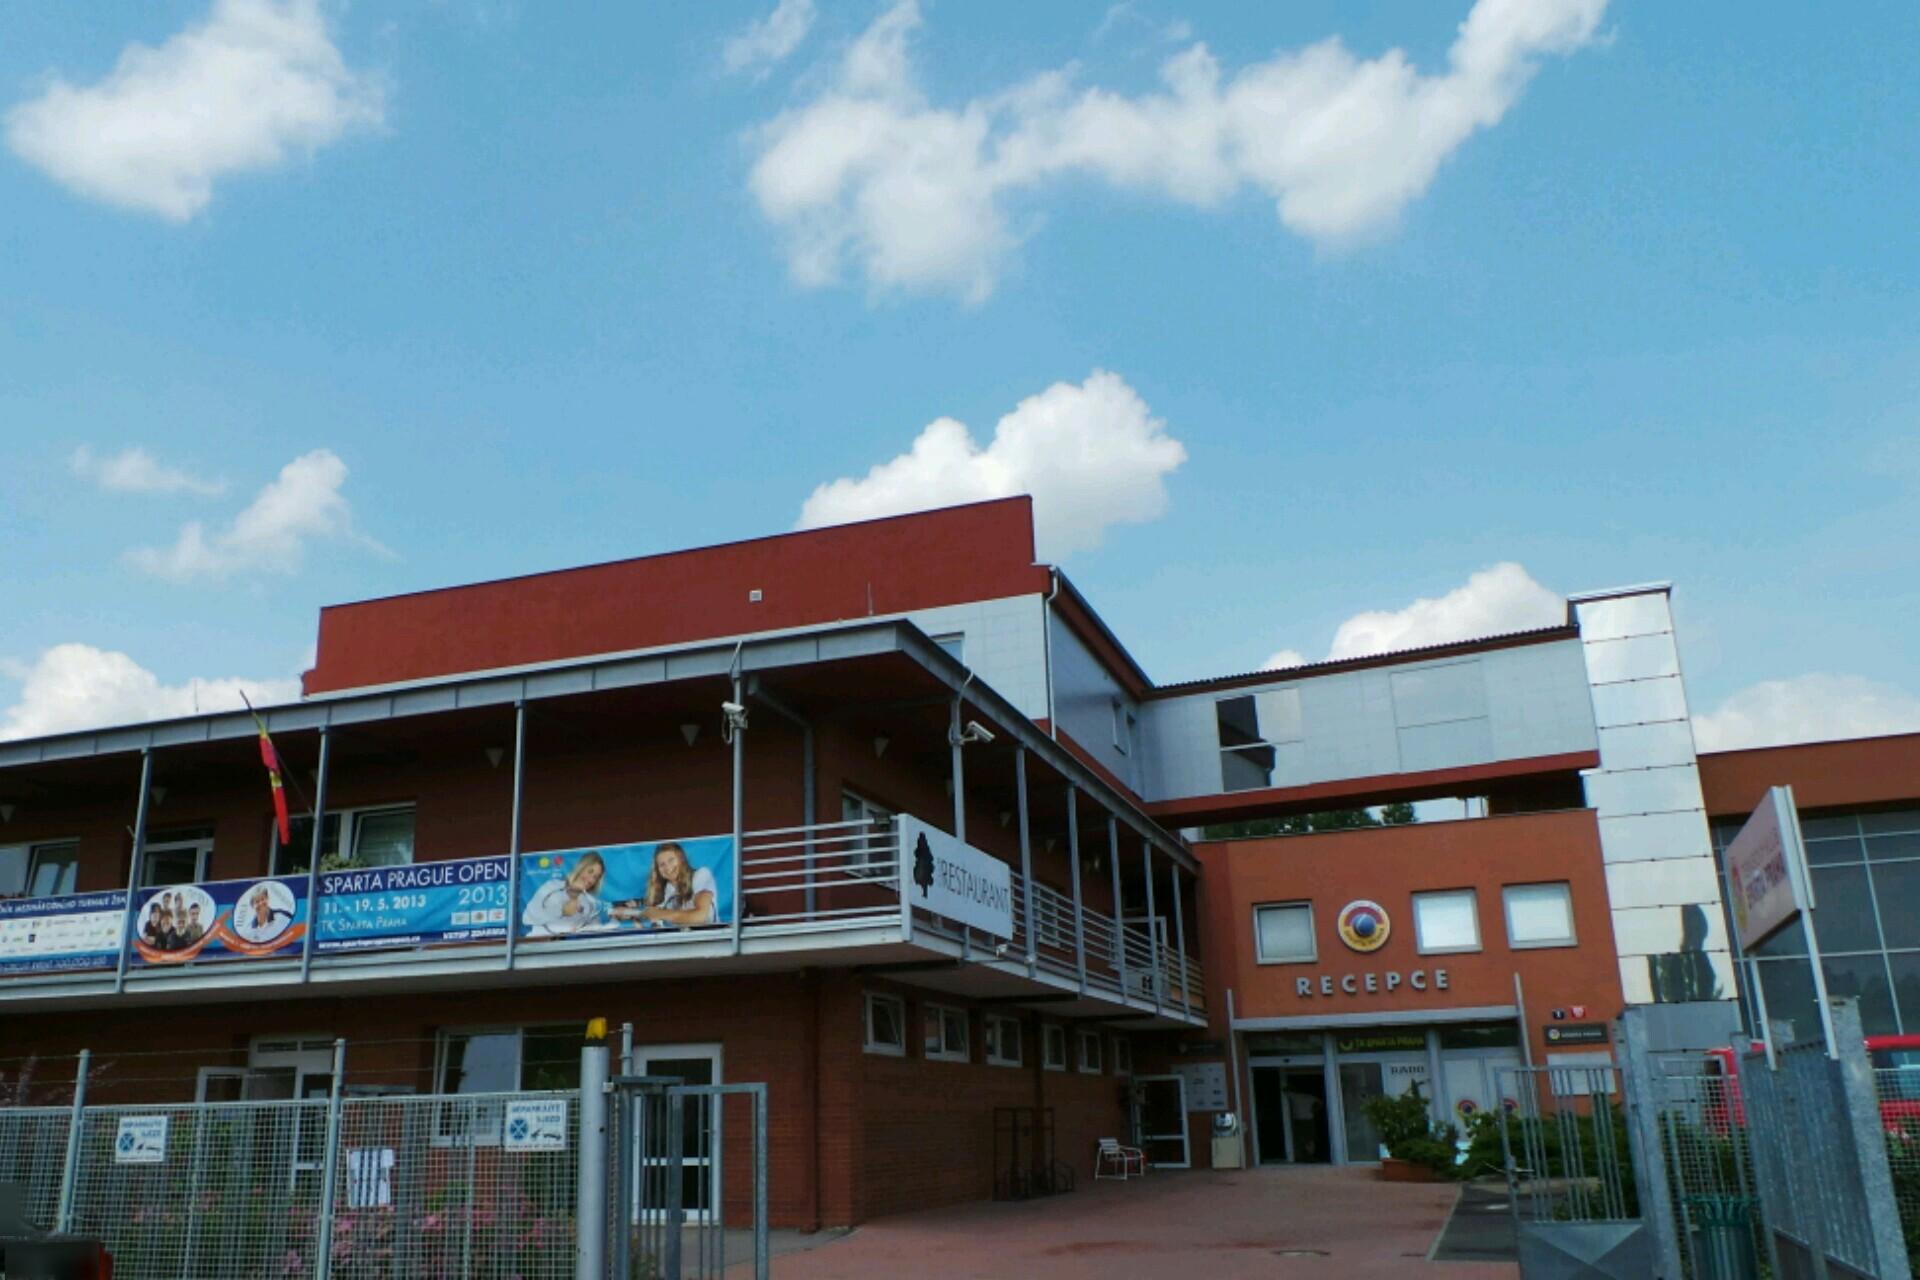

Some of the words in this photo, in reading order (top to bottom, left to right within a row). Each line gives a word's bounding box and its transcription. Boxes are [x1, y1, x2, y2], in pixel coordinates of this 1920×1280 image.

[324, 872, 383, 895] SPARTA
[387, 866, 453, 889] PRAGUE
[458, 860, 509, 883] OPEN
[940, 858, 1009, 914] RESTAURANT
[393, 894, 427, 910] 2013
[458, 884, 508, 906] 2013
[1296, 969, 1450, 996] RECEPCE
